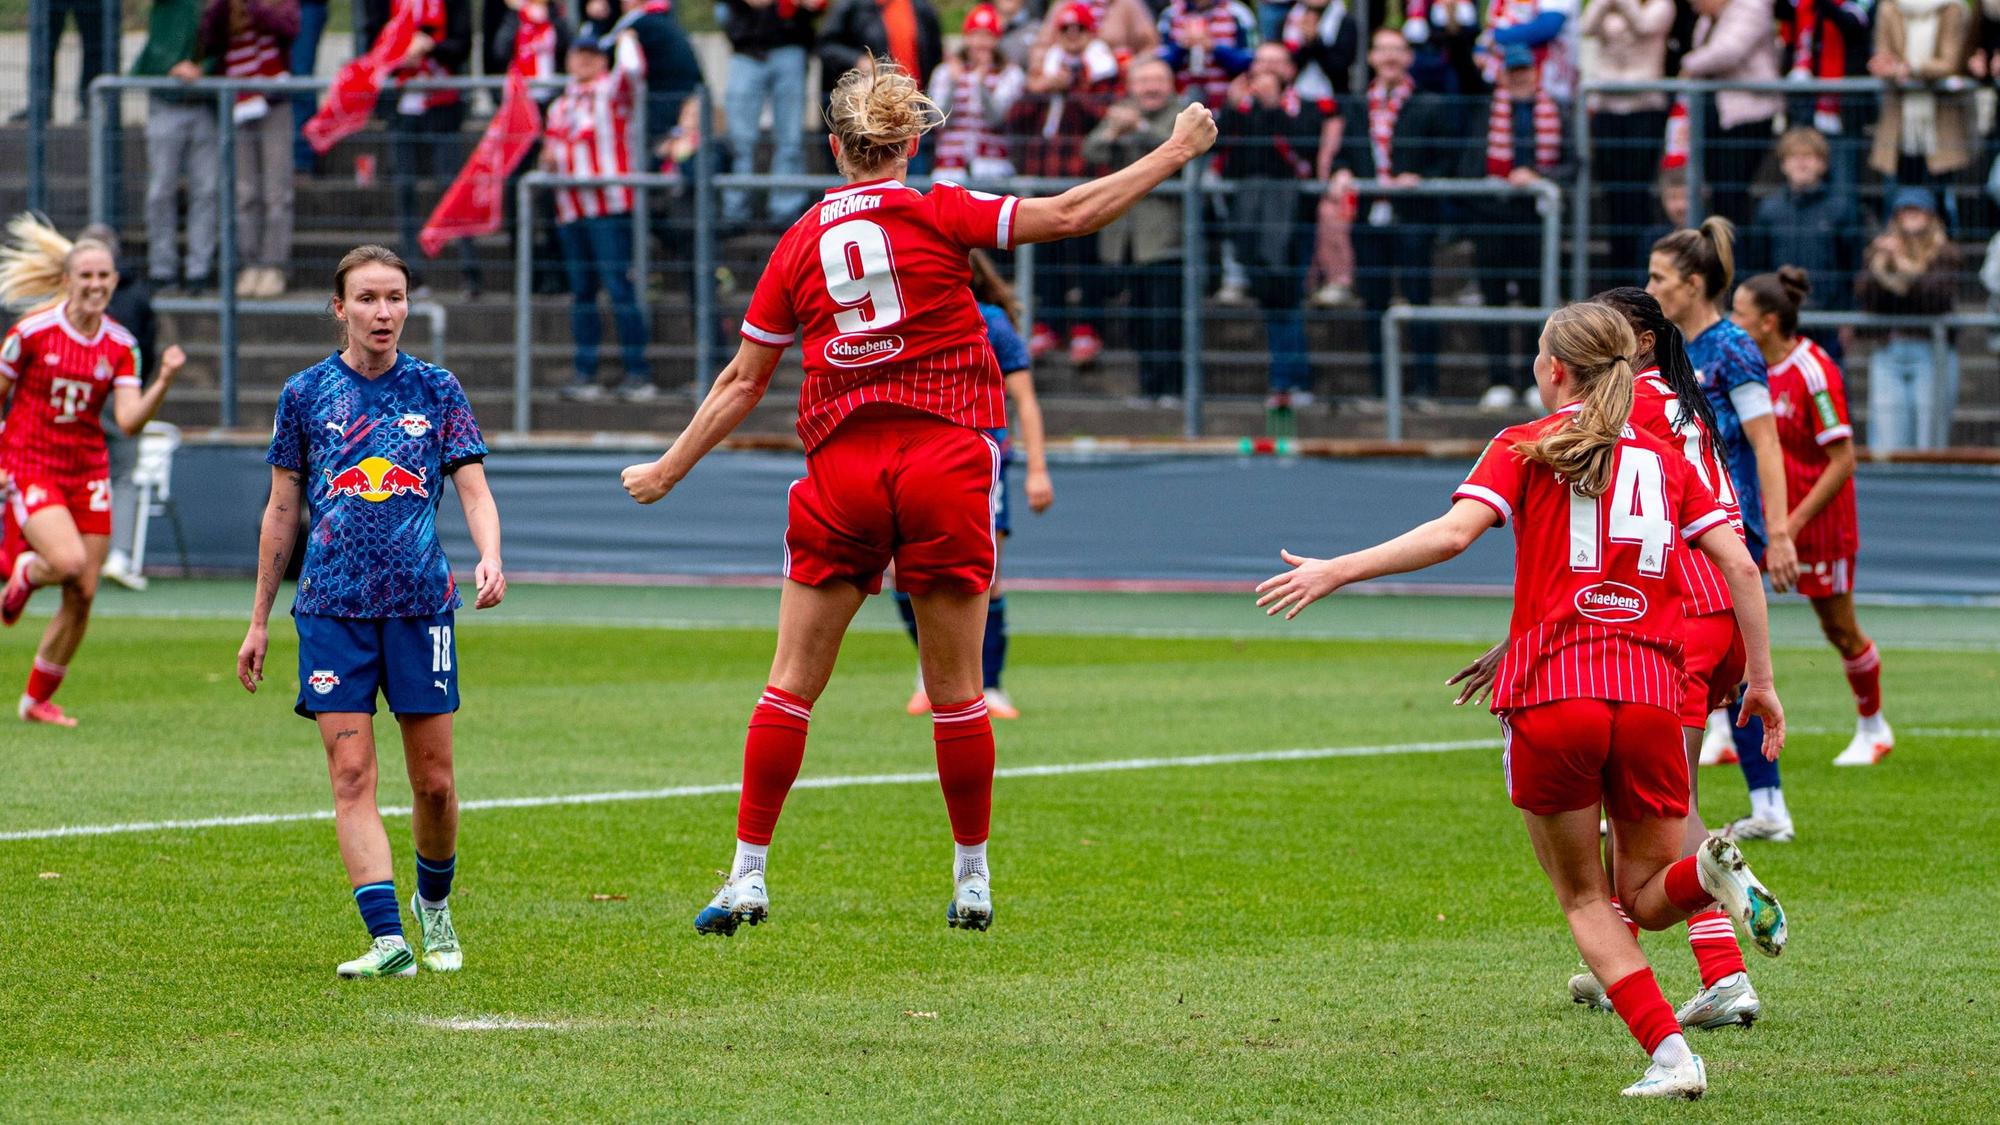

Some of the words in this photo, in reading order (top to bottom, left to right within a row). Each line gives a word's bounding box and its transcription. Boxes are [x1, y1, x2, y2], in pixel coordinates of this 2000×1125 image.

[819, 219, 907, 334] 9
[831, 338, 894, 356] Schaebens
[1569, 444, 1675, 579] 14
[428, 625, 452, 672] 18
